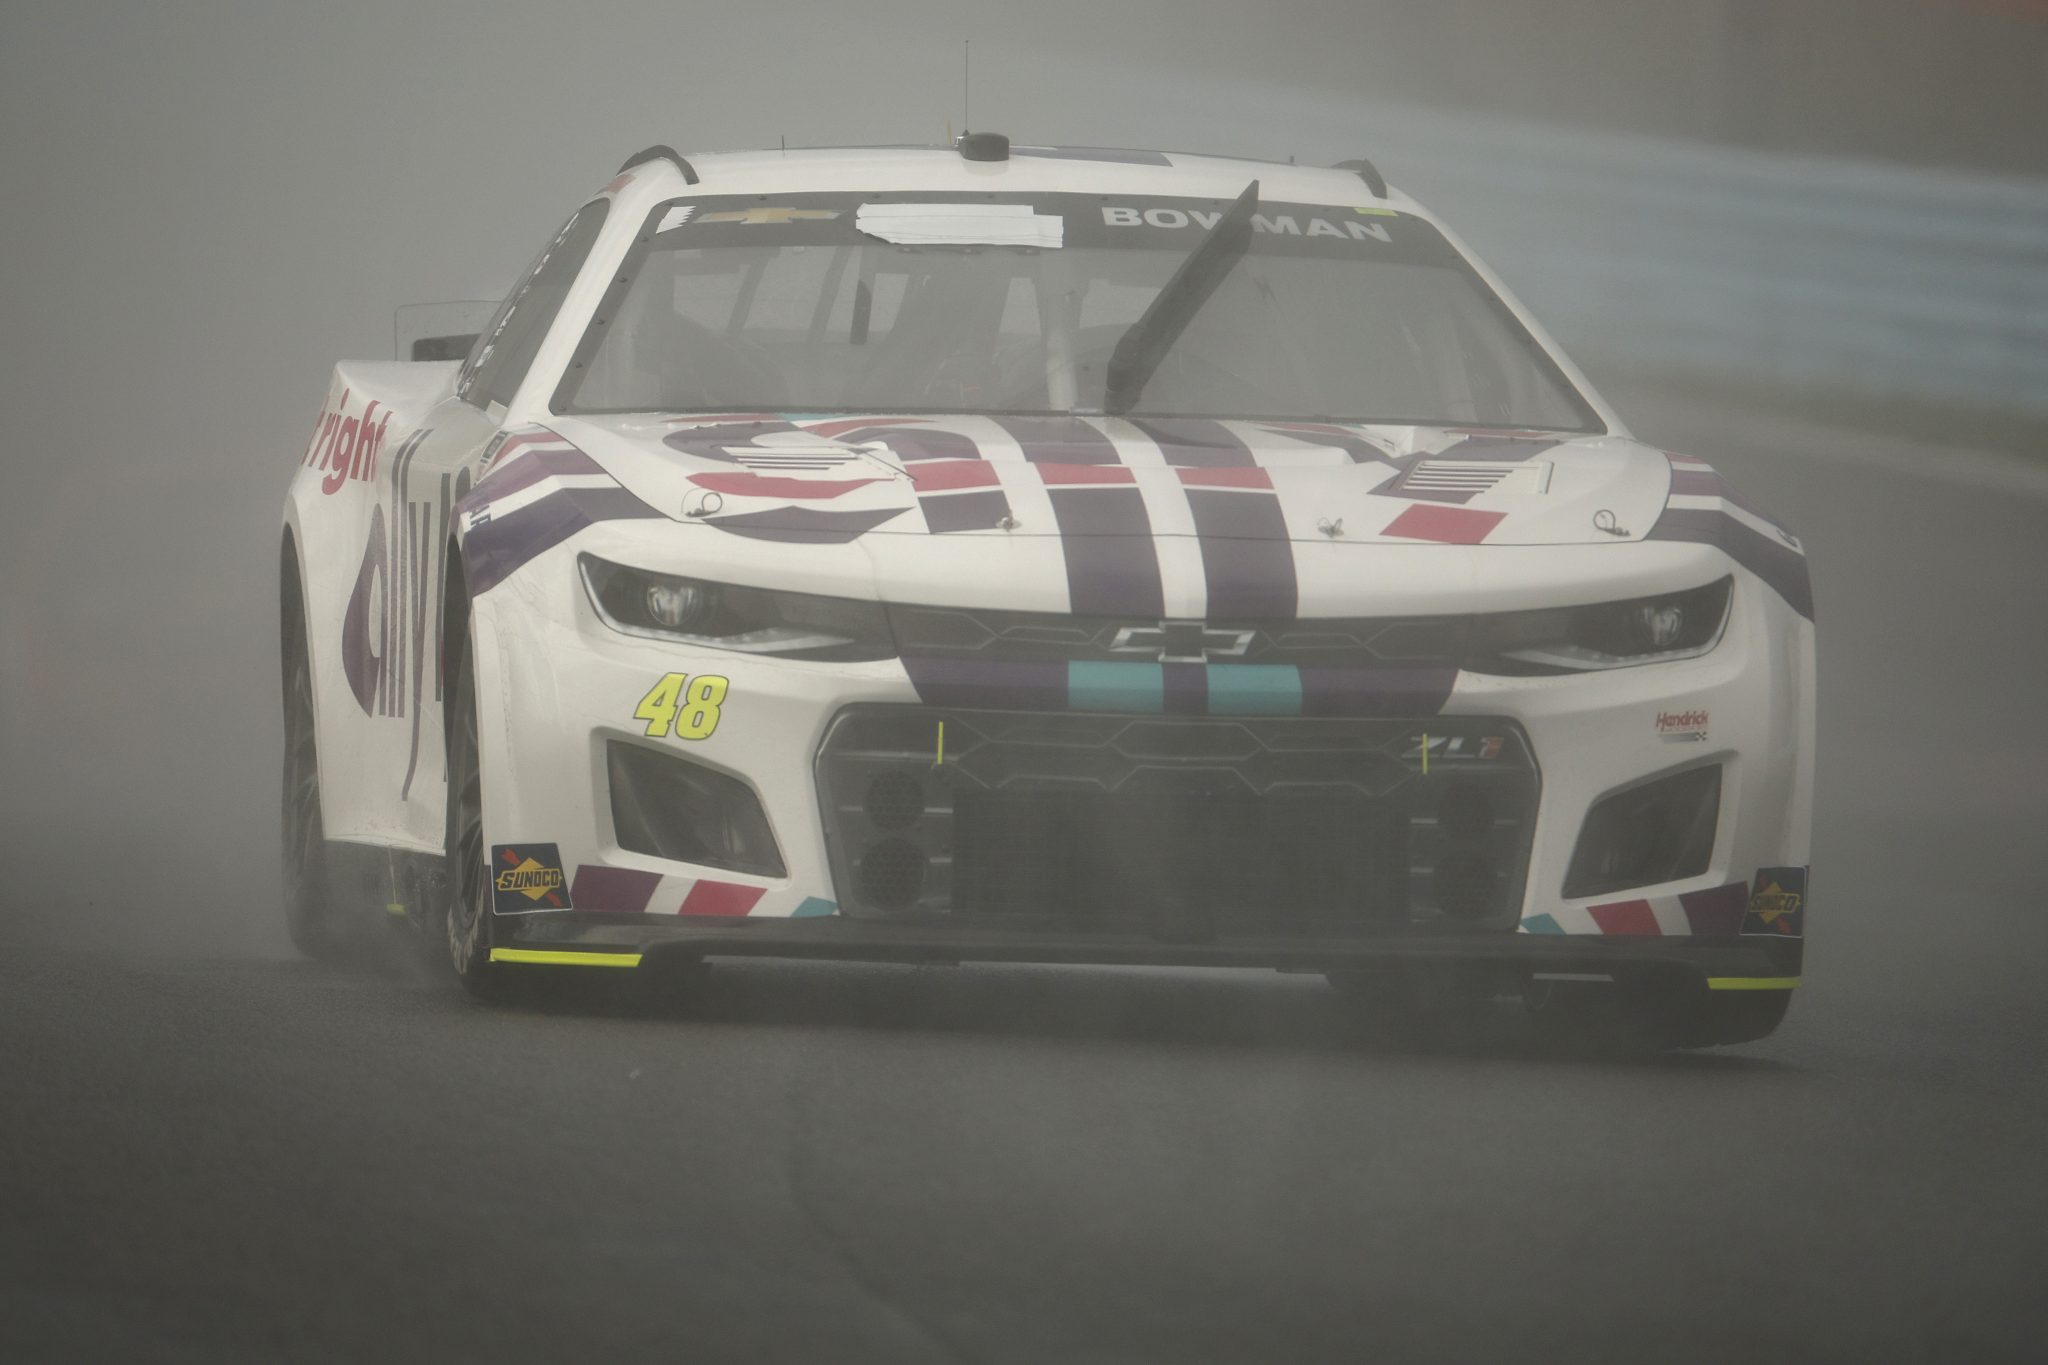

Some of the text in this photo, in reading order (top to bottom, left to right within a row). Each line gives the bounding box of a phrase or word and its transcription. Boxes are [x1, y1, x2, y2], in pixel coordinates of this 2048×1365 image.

[342, 428, 434, 801] ally
[633, 671, 729, 741] 48
[1656, 710, 1709, 732] Hendrick
[1401, 736, 1504, 759] ZL1
[499, 869, 560, 890] SUNOCO
